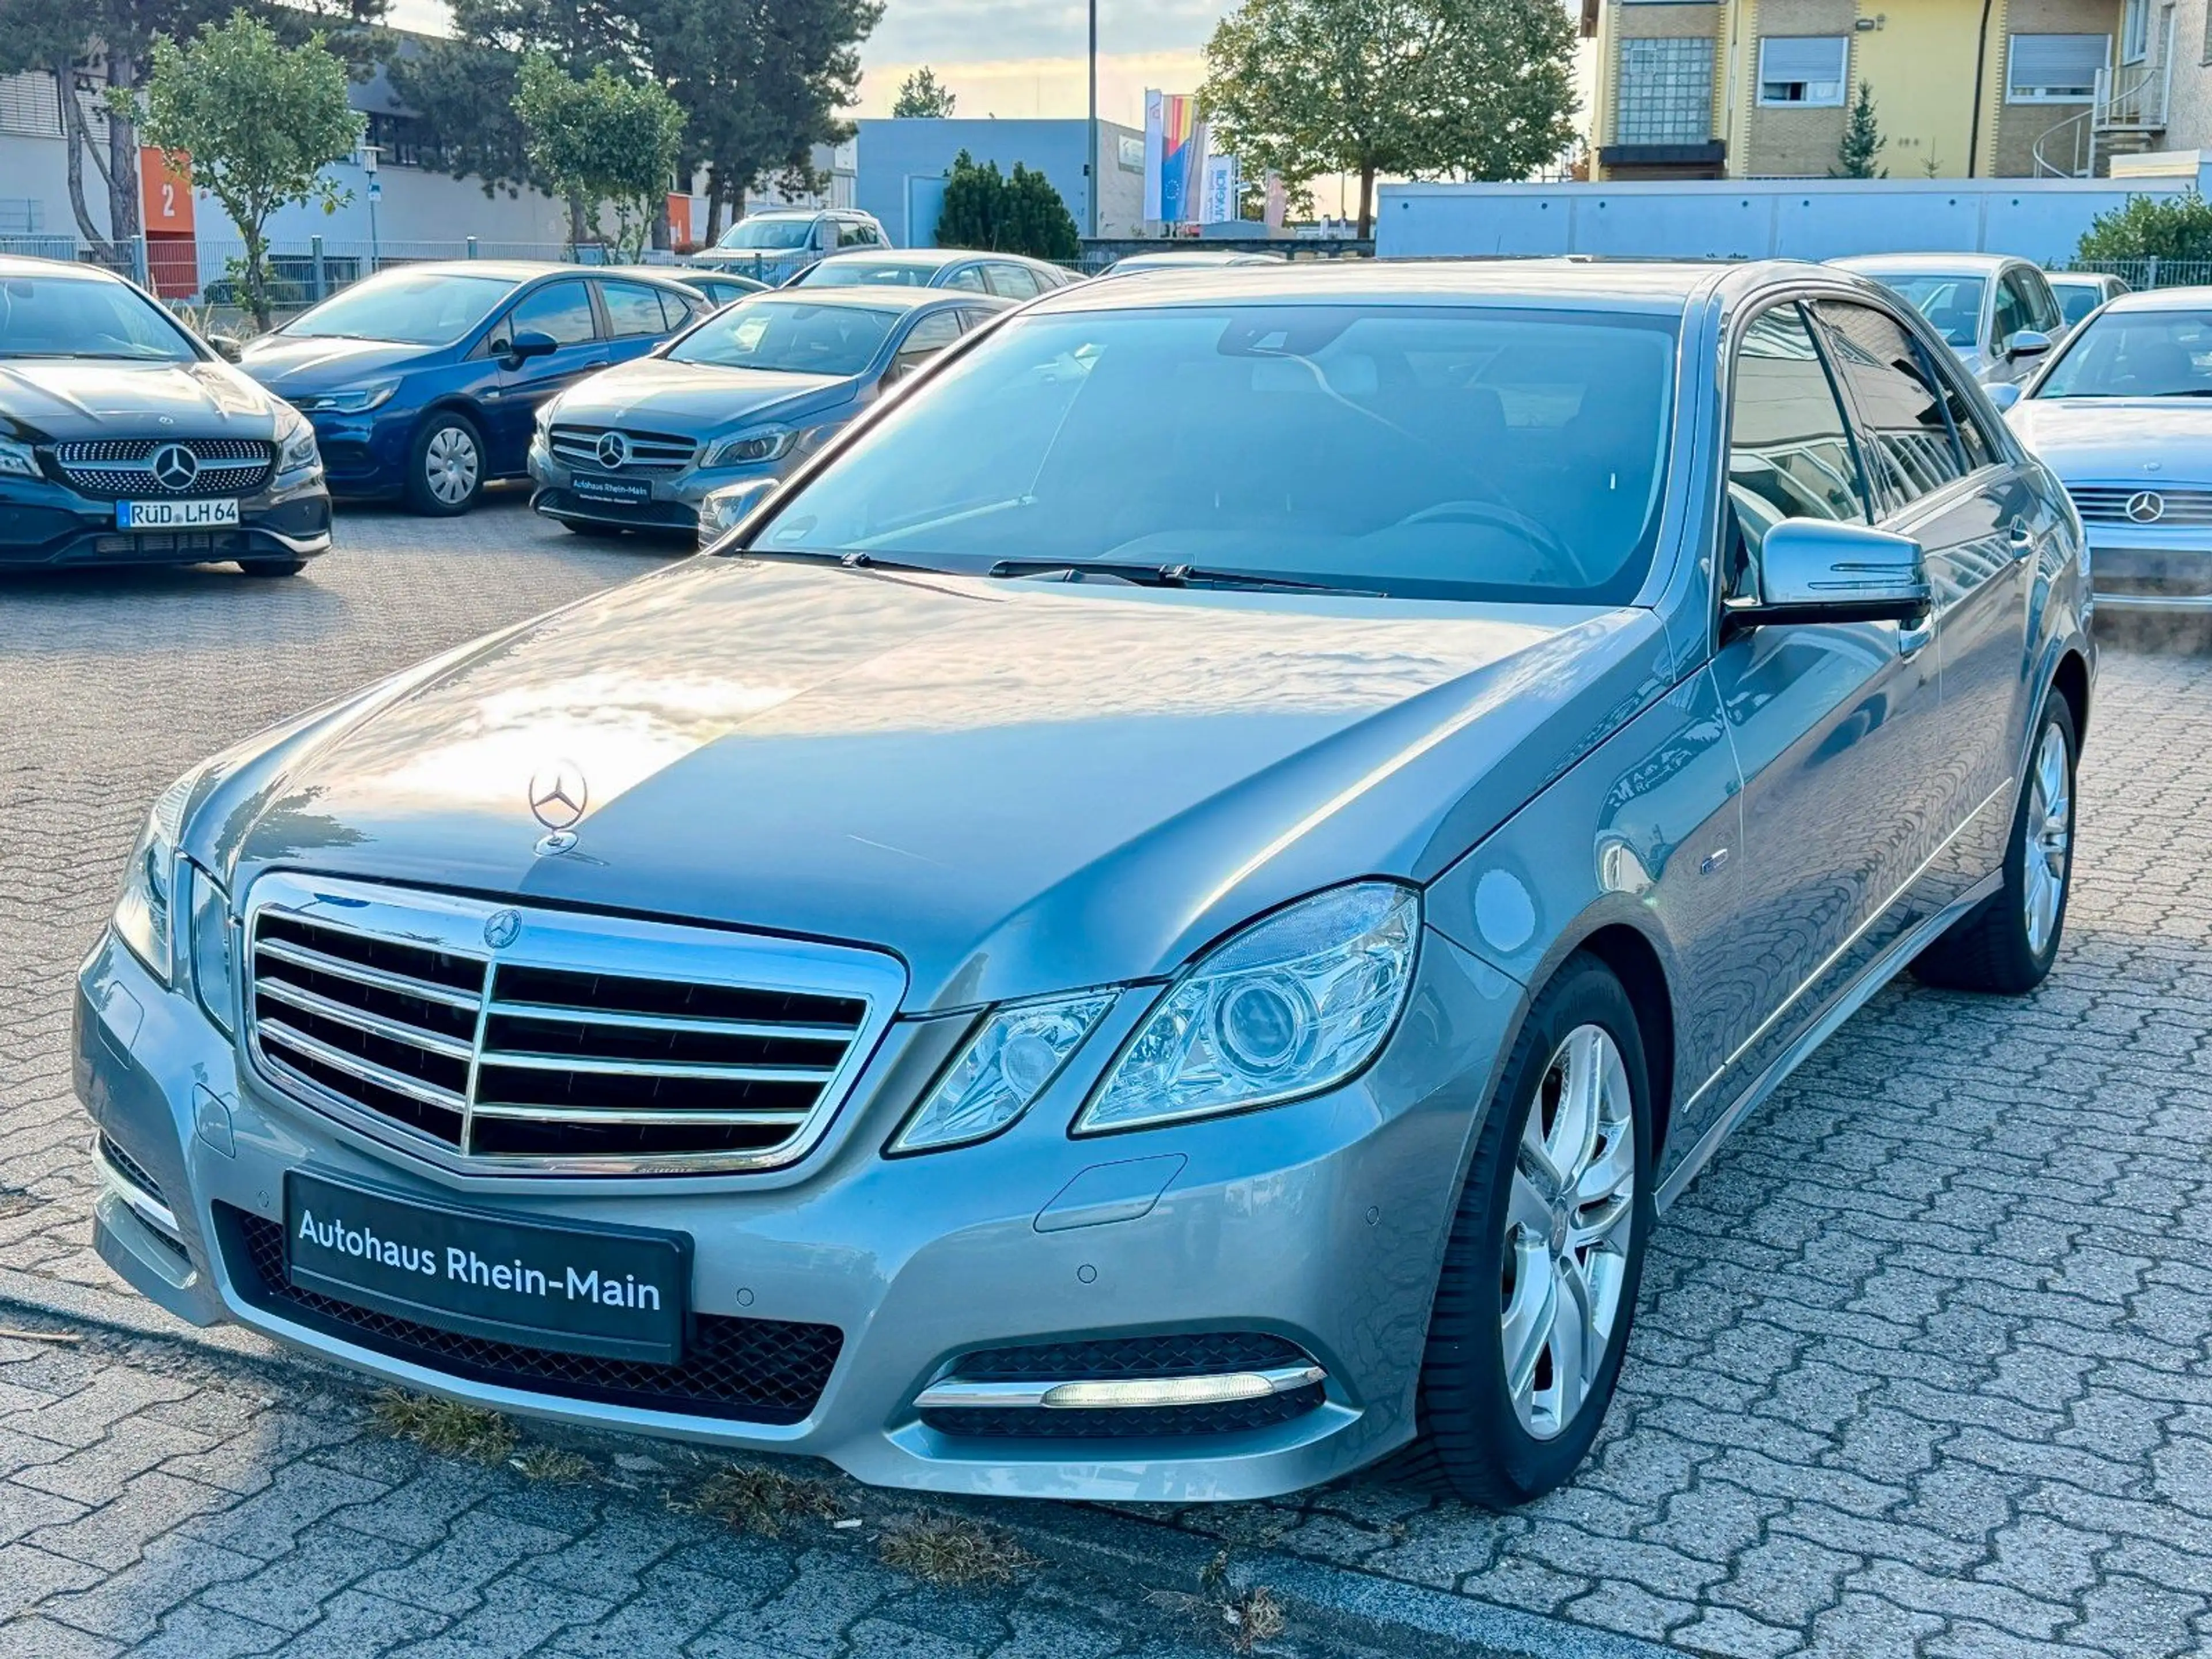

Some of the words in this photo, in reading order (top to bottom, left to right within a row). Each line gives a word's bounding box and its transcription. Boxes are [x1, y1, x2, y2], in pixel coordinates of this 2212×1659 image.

[162, 184, 175, 217] 2
[131, 505, 172, 523] RÜD
[186, 503, 209, 522] LH
[215, 502, 236, 521] 64
[298, 1210, 436, 1276] Autohaus
[447, 1247, 661, 1310] Rhein-Main
